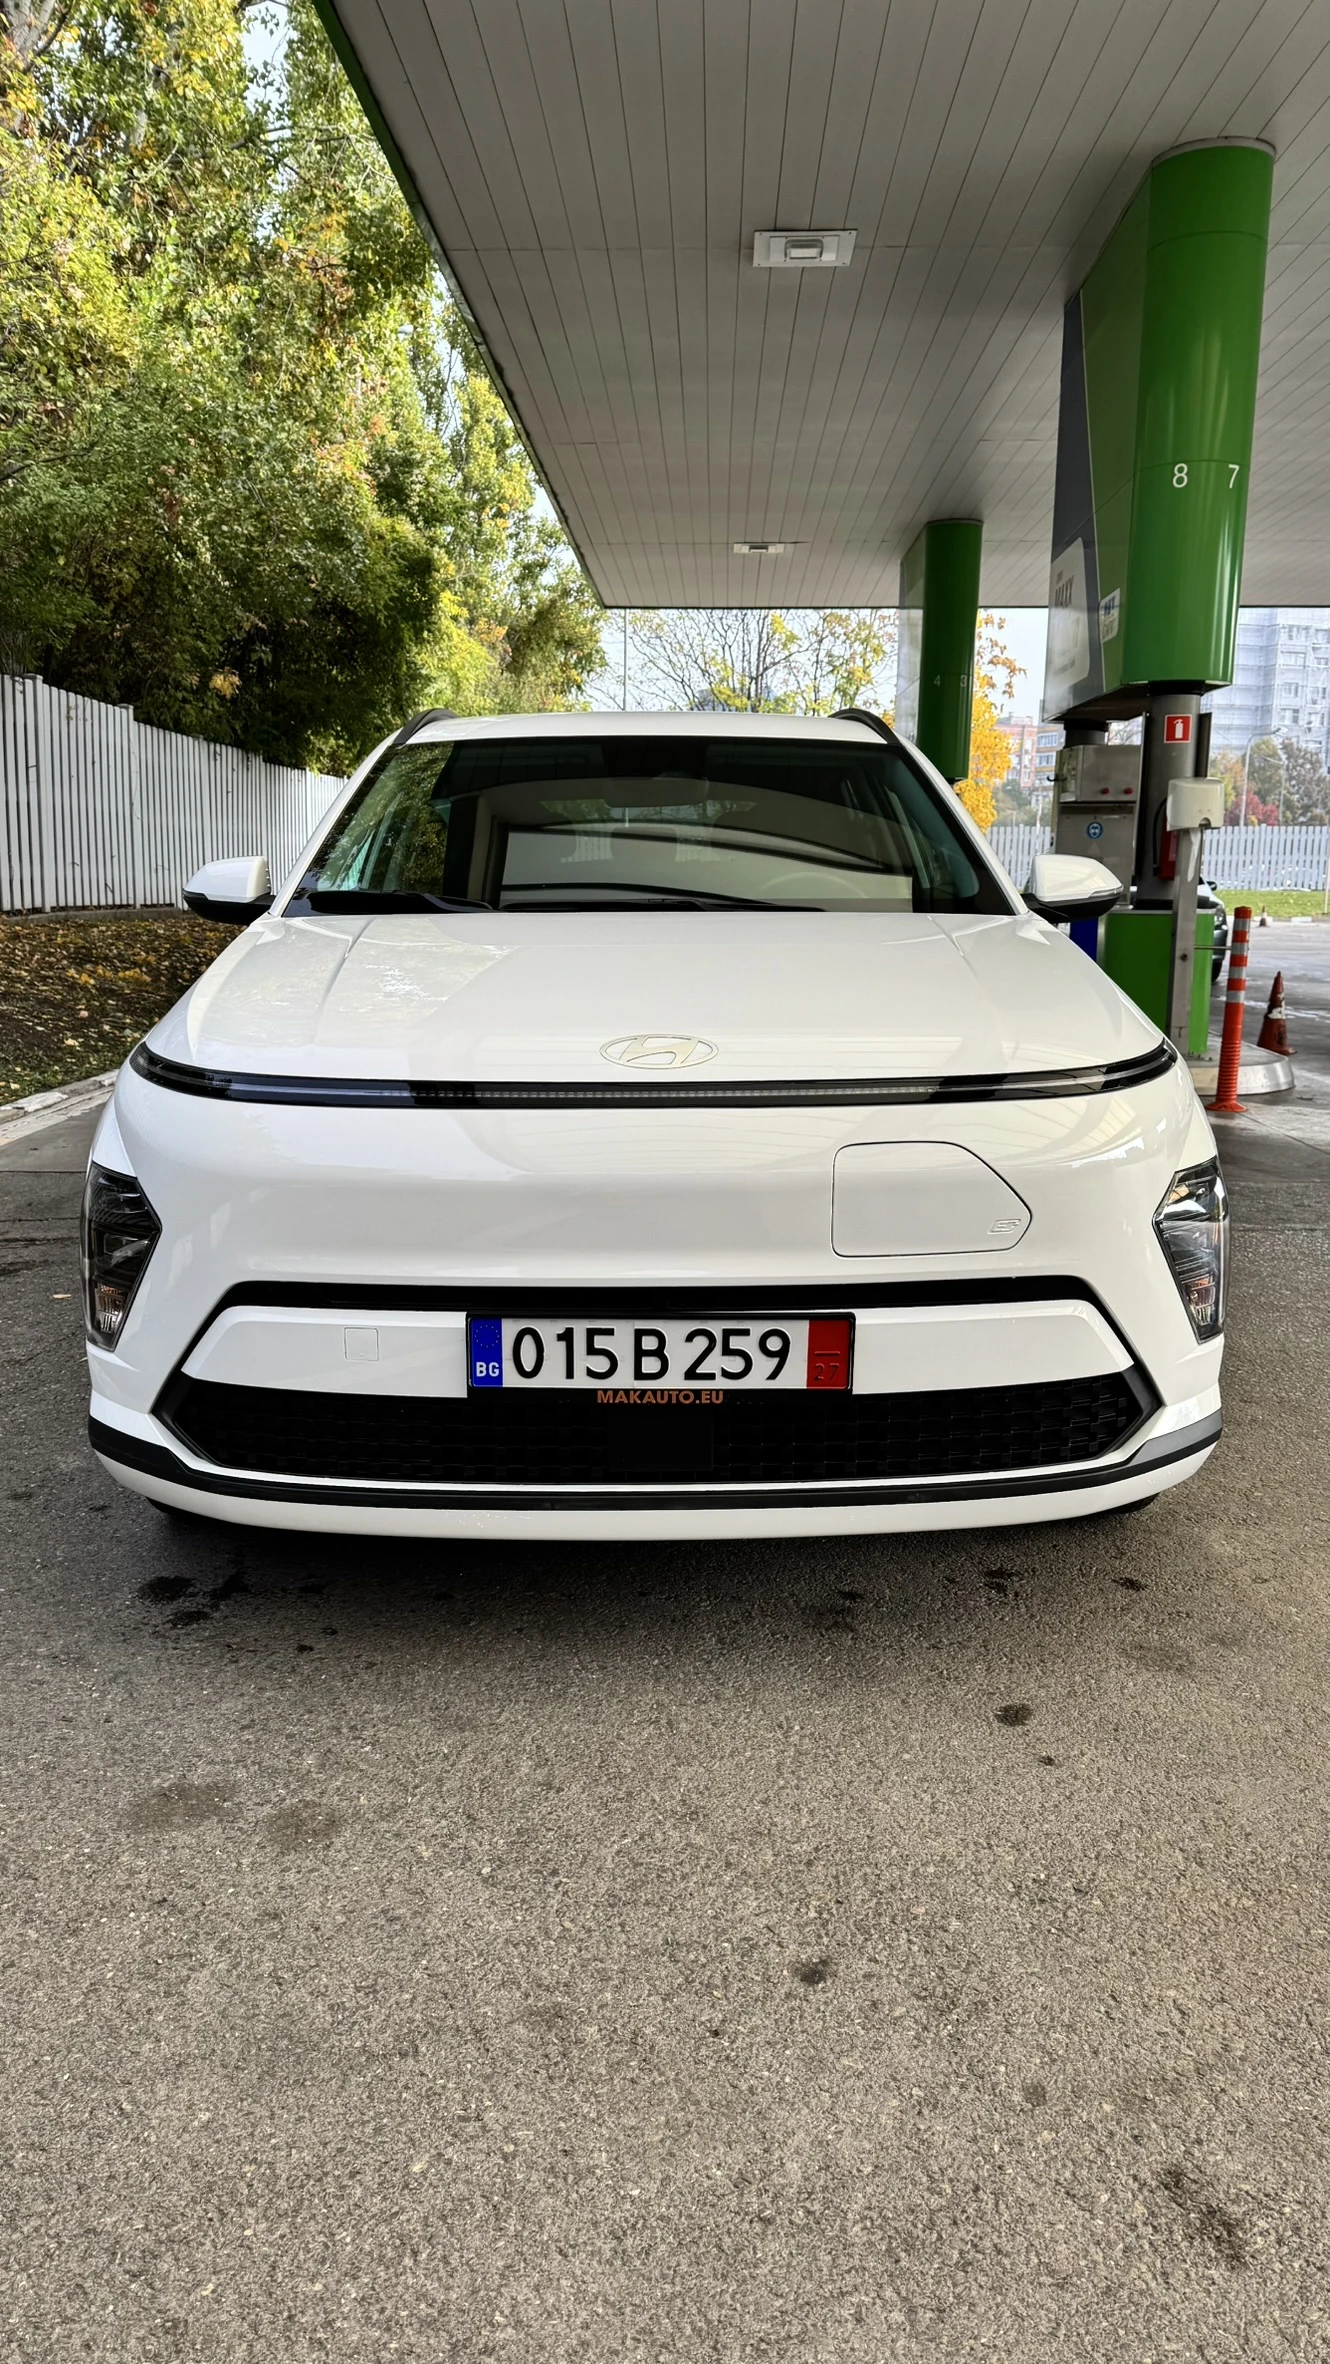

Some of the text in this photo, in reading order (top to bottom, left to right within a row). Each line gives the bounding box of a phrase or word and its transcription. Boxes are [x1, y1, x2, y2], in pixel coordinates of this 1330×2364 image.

[1172, 462, 1240, 489] 8 7
[933, 674, 968, 688] 4 3
[475, 1361, 500, 1377] BG
[814, 1362, 840, 1381] 27
[596, 1389, 724, 1405] MAKAUTO.EU
